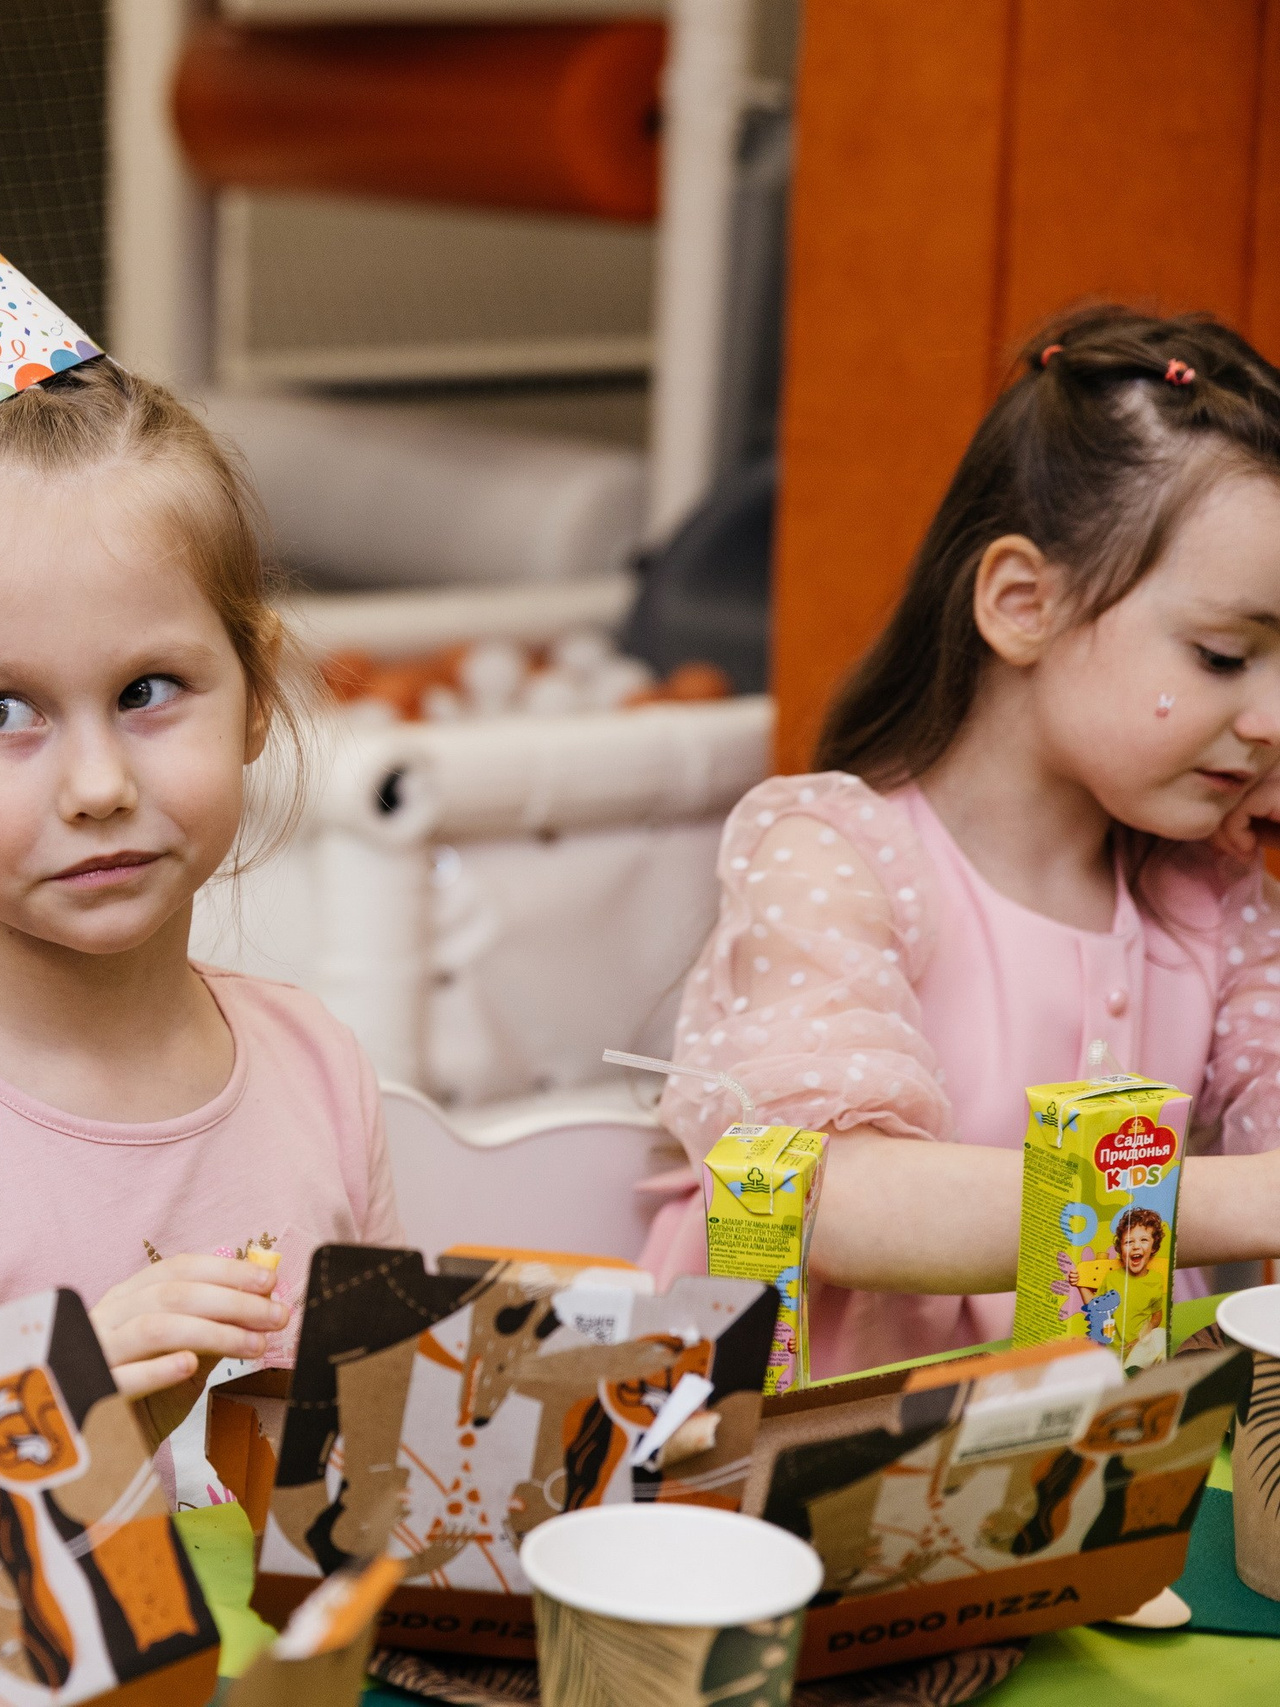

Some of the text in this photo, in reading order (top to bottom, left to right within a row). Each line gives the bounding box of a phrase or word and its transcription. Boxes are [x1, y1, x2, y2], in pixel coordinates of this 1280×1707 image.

[1114, 1134, 1154, 1147] Сады
[1100, 1144, 1170, 1165] Придонья
[1106, 1166, 1161, 1190] KIDS
[470, 1617, 536, 1639] PIZ
[828, 1585, 1080, 1652] DODO PIZZA
